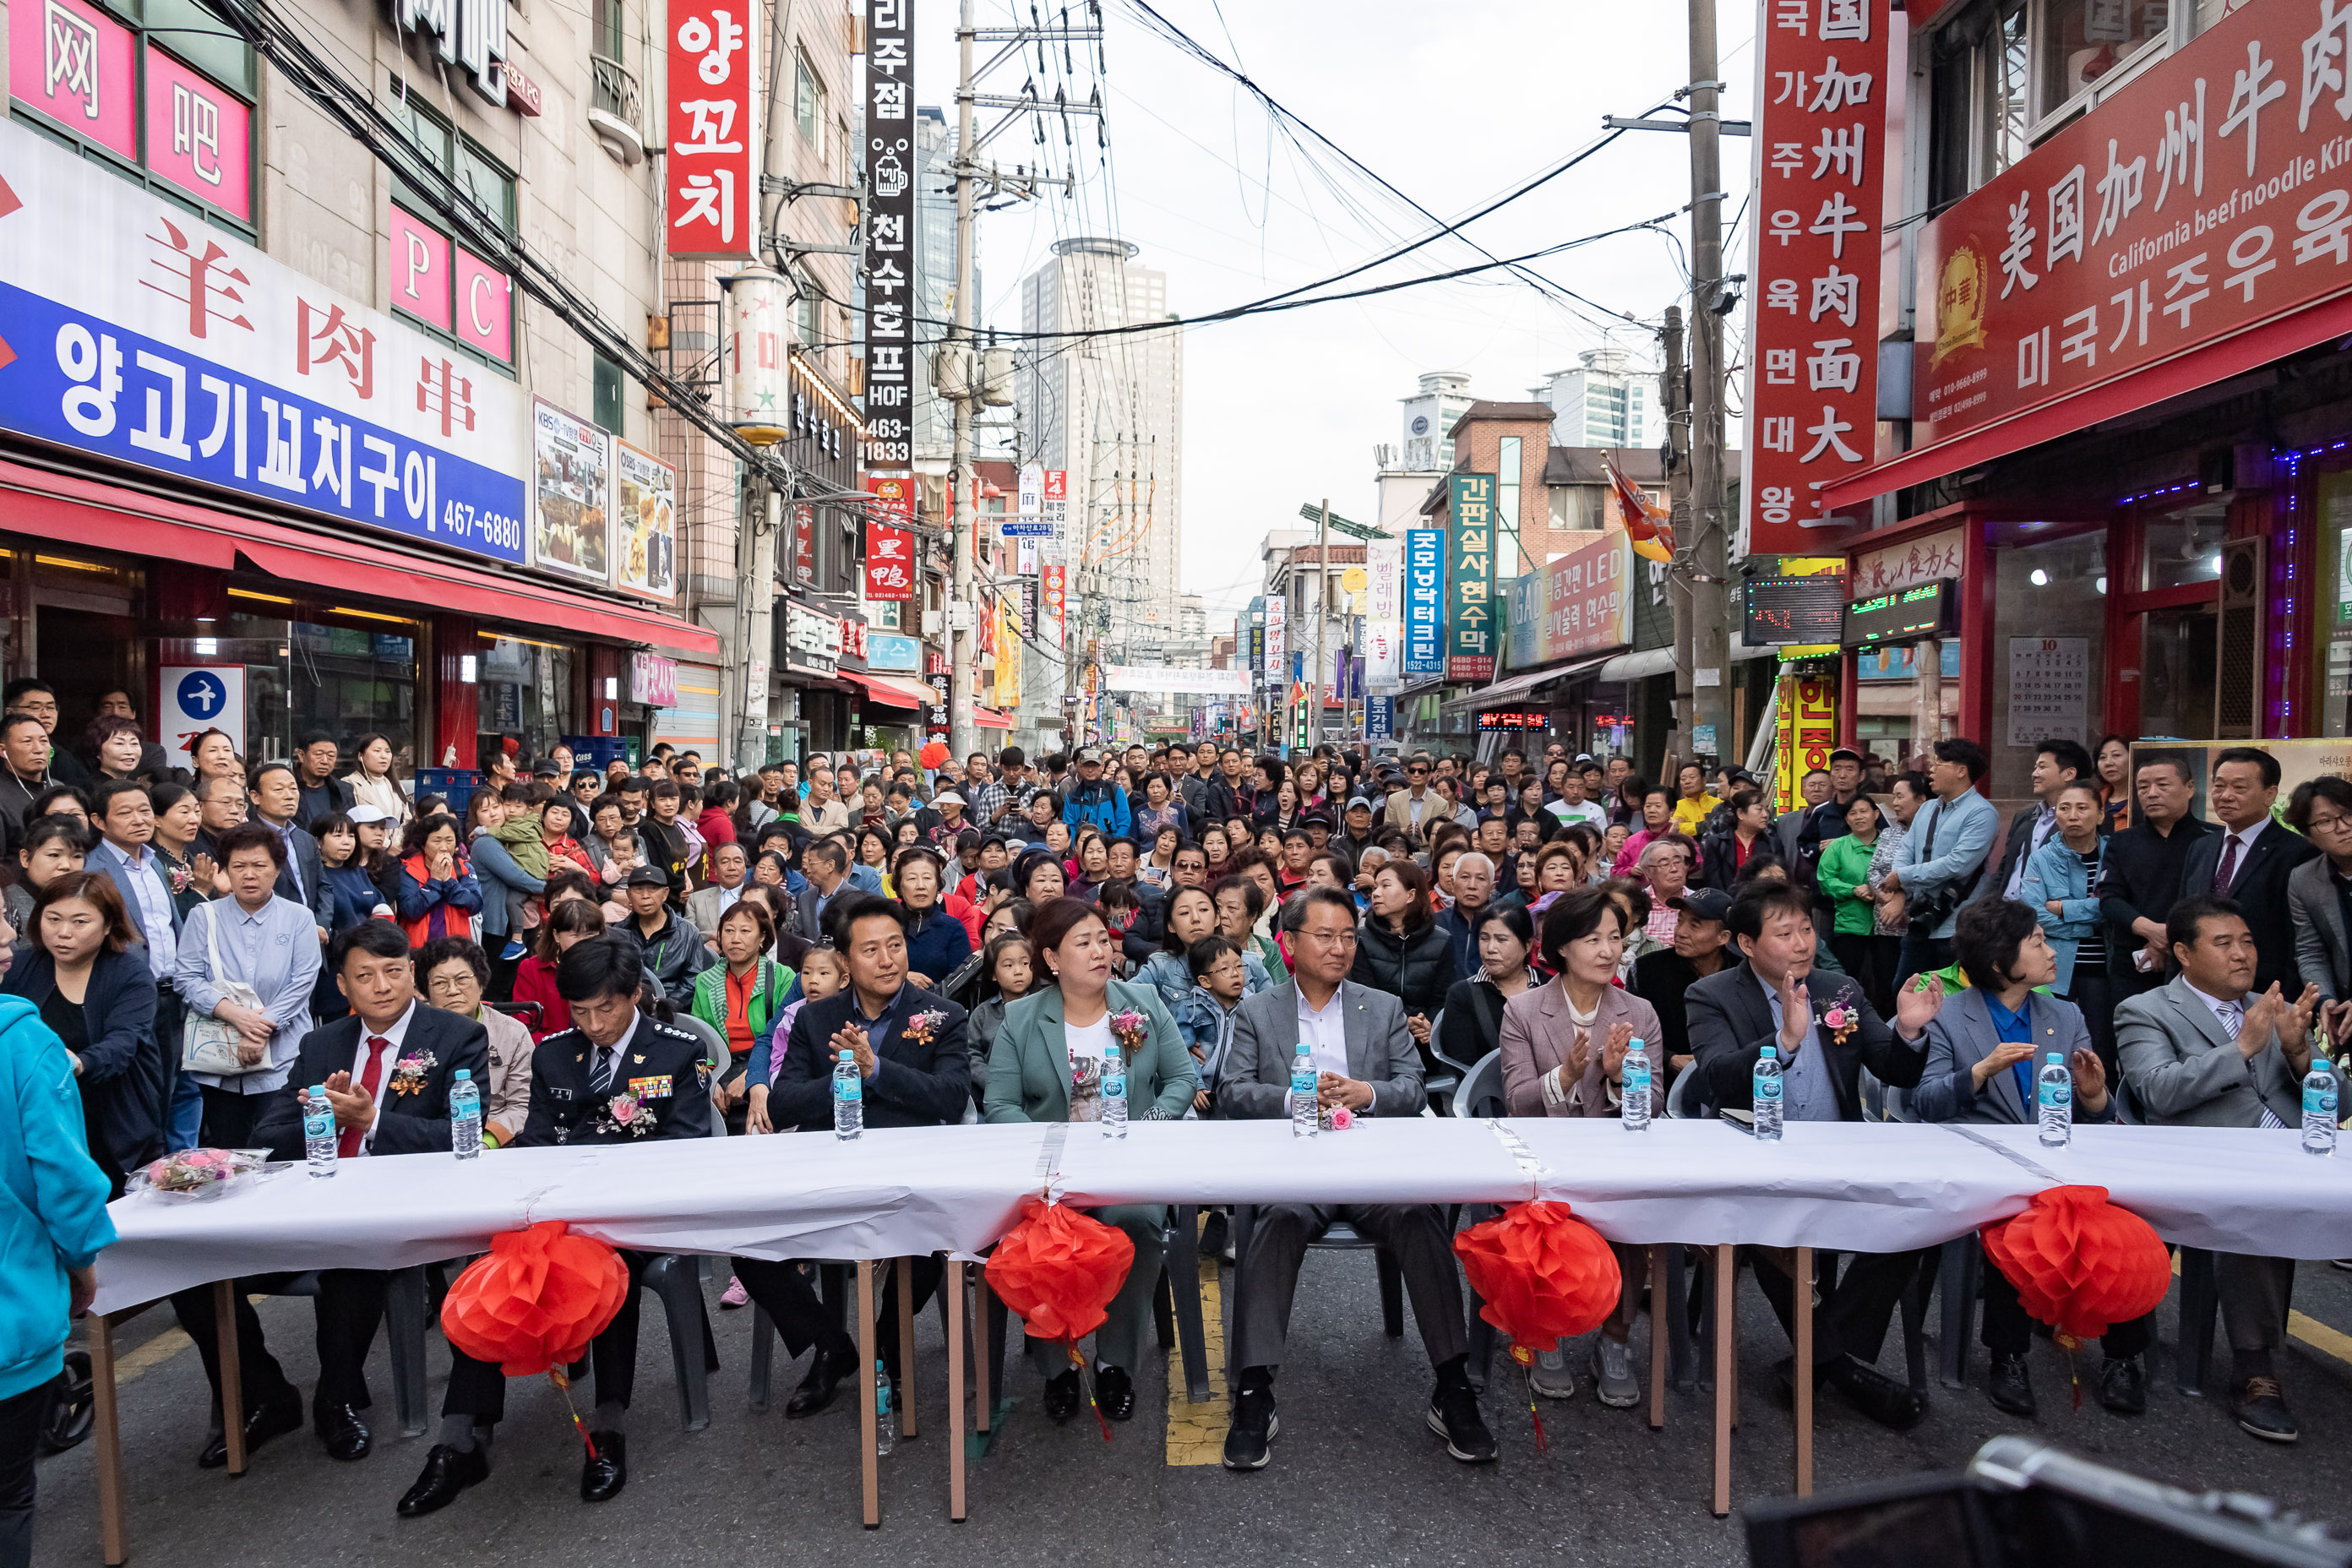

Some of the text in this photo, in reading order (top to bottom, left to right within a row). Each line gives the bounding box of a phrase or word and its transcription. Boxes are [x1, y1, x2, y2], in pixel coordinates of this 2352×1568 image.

[674, 9, 743, 243] 양꼬치
[2109, 220, 2191, 280] California
[2194, 188, 2240, 237] beef
[2240, 155, 2316, 214] noodle
[871, 214, 906, 382] 천수호프
[1946, 276, 1971, 313] 中華
[138, 215, 476, 439] 羊肉串
[869, 385, 907, 406] HOF
[55, 322, 521, 552] 양고기꼬치구이 467-6880
[538, 411, 553, 431] KBS
[865, 442, 909, 462] 1833
[1458, 478, 1490, 653] 간판실사현수막
[1587, 547, 1622, 589] LED
[1376, 562, 1394, 620] 빨래방
[1407, 660, 1441, 671] 1522-4315
[1371, 696, 1387, 733] 중고가전
